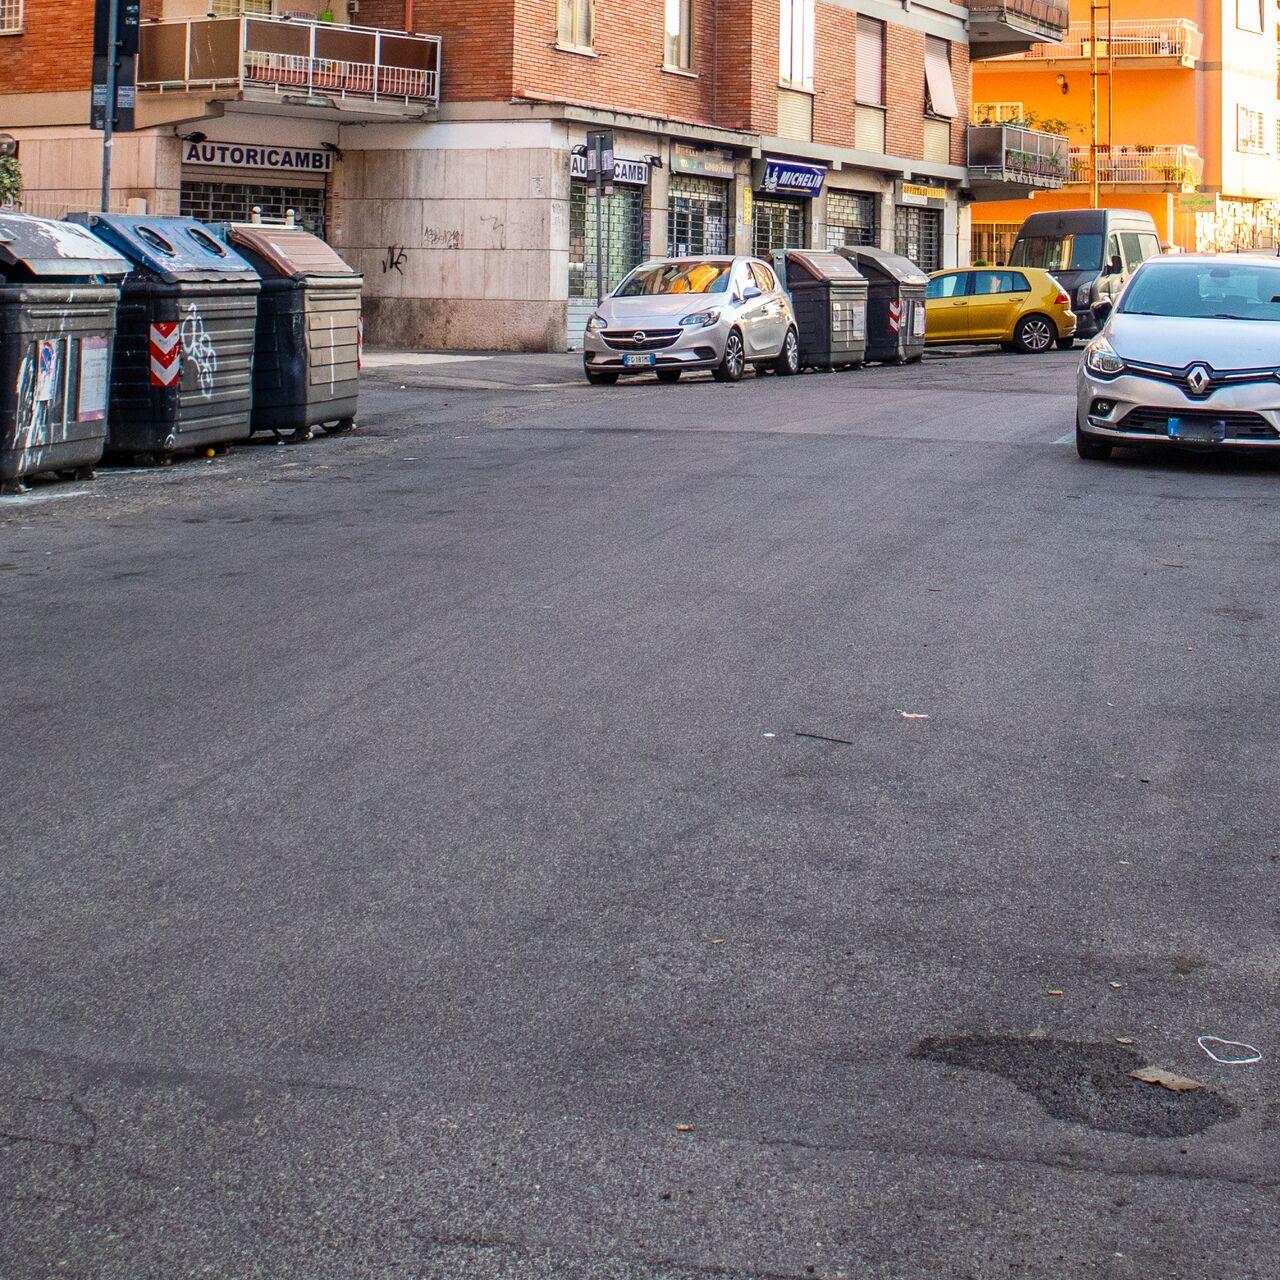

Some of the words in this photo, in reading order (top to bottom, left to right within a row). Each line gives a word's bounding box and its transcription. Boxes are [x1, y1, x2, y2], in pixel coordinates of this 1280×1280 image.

[186, 143, 331, 170] AUTORICAMBI
[571, 157, 648, 182] AUCAMBI
[778, 171, 824, 188] MICHELIN
